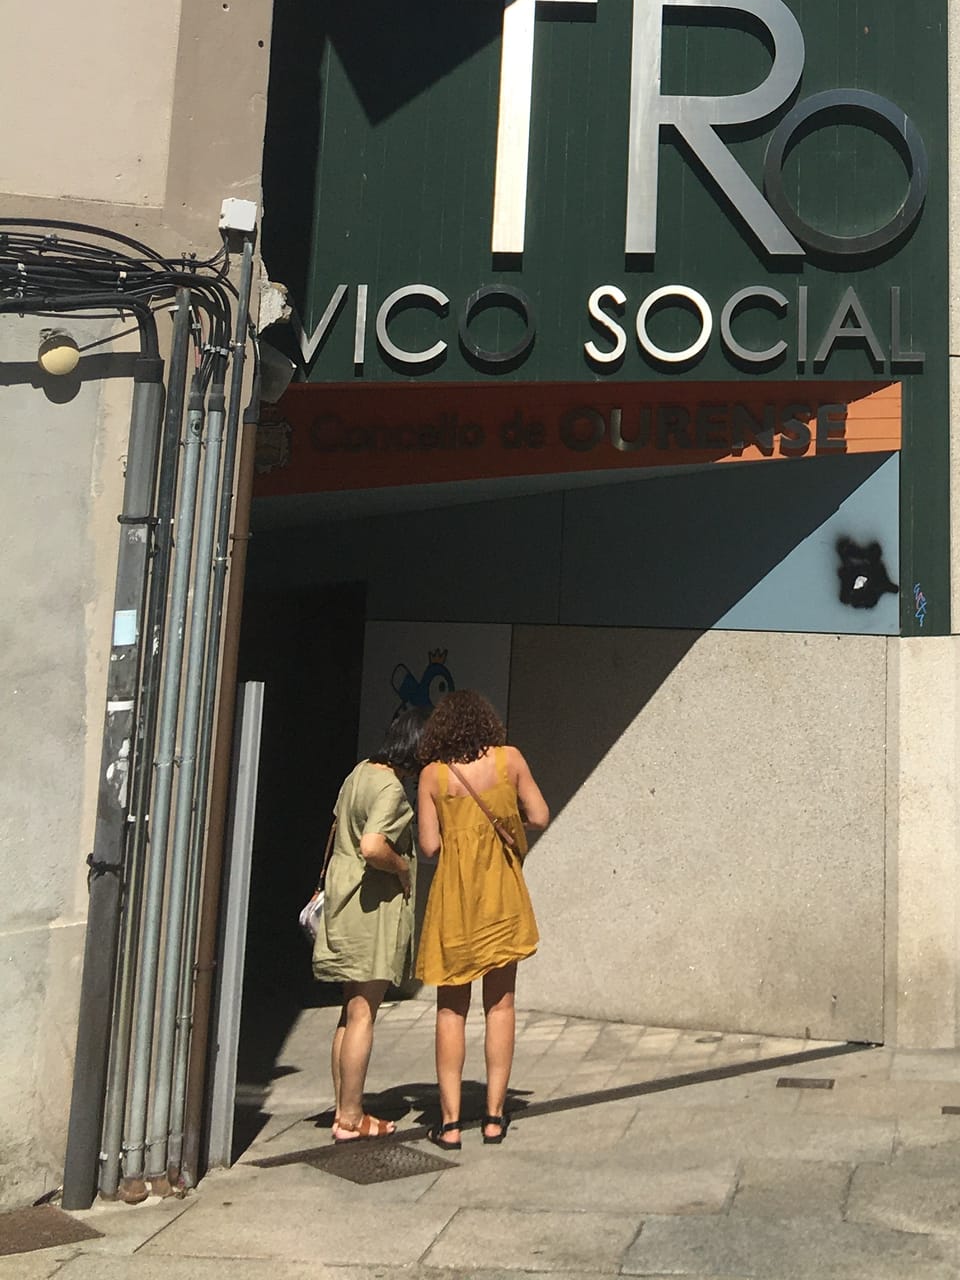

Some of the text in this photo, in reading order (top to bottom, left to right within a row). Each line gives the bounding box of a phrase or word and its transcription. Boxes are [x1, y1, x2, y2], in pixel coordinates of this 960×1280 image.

[583, 284, 926, 363] SOCIAL
[309, 403, 847, 454] Concello de OURENSE
